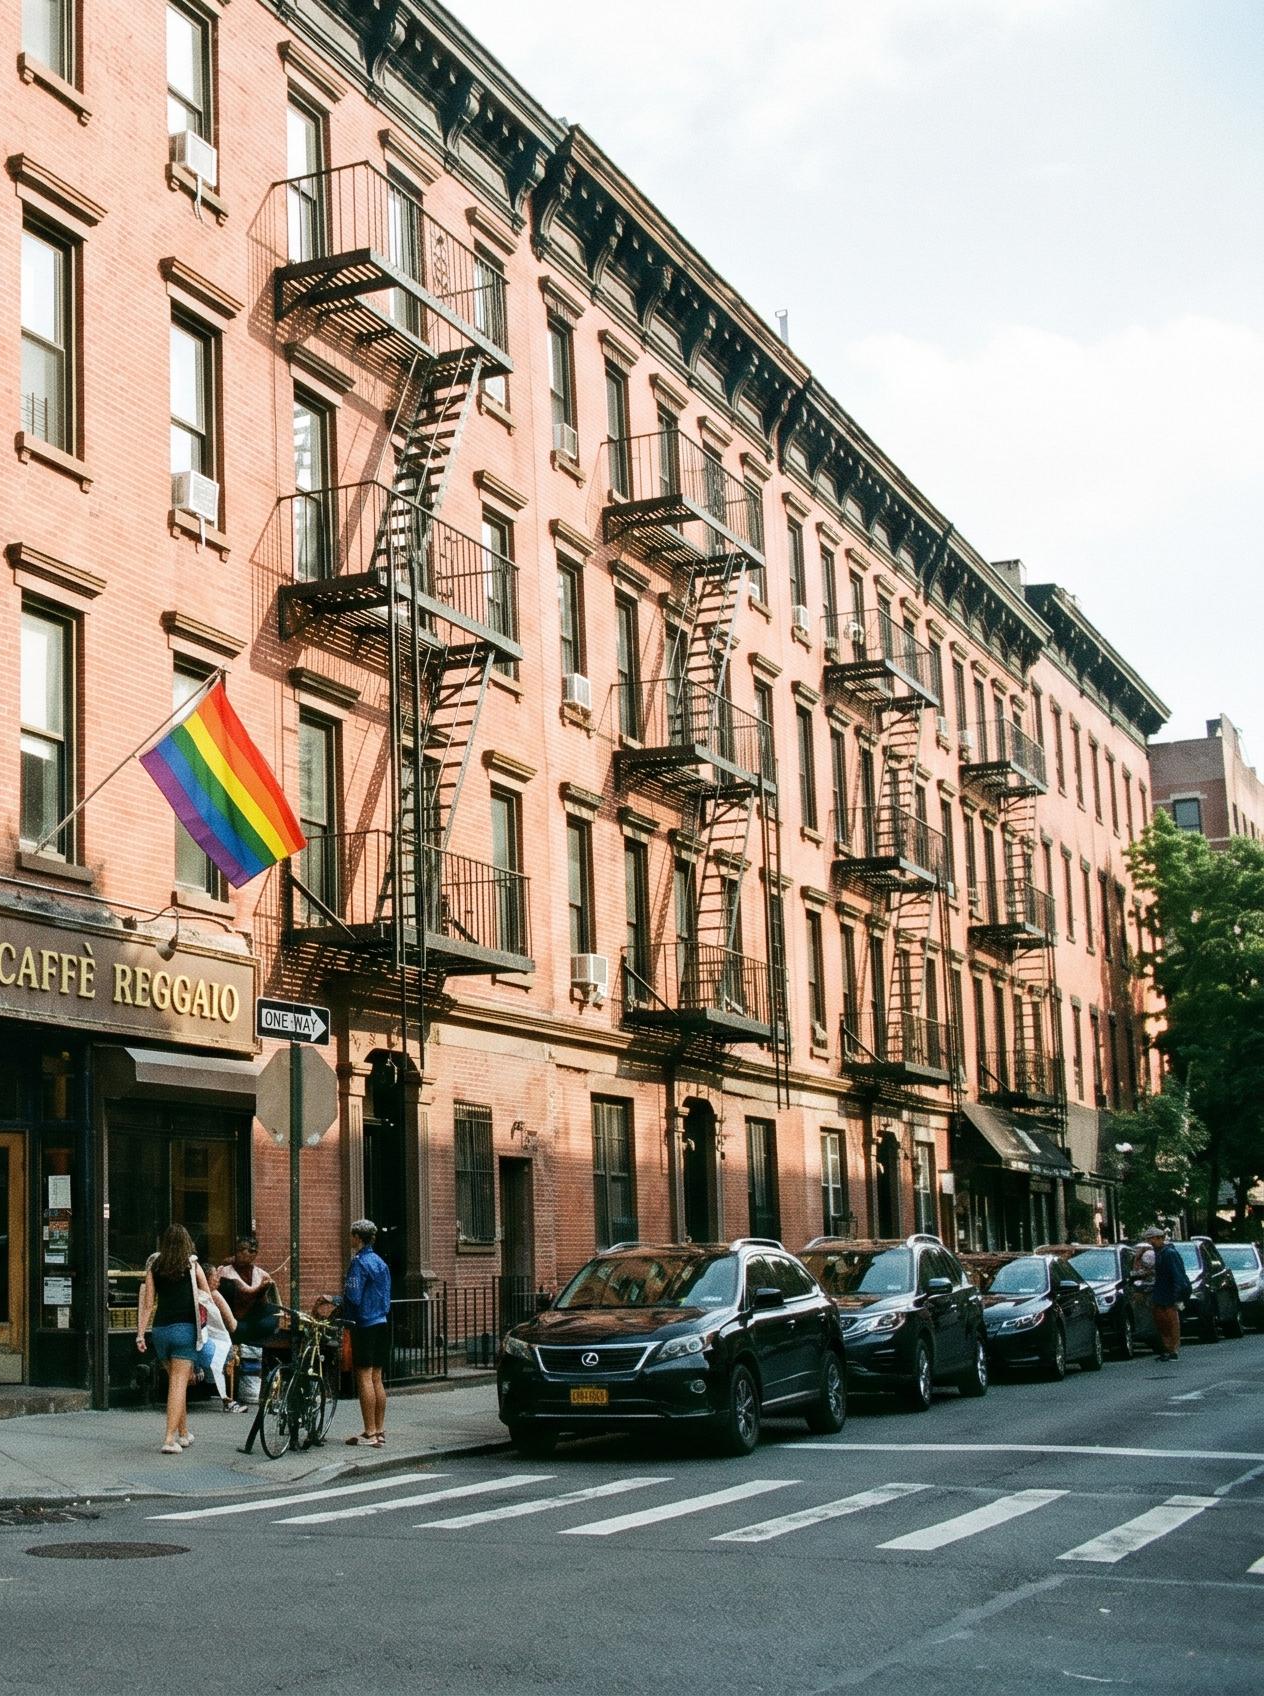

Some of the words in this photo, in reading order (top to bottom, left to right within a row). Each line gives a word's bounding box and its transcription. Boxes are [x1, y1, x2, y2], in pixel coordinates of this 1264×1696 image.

[113, 963, 239, 1023] REGGAIO
[265, 1011, 289, 1029] ONE
[294, 1014, 318, 1033] WAY
